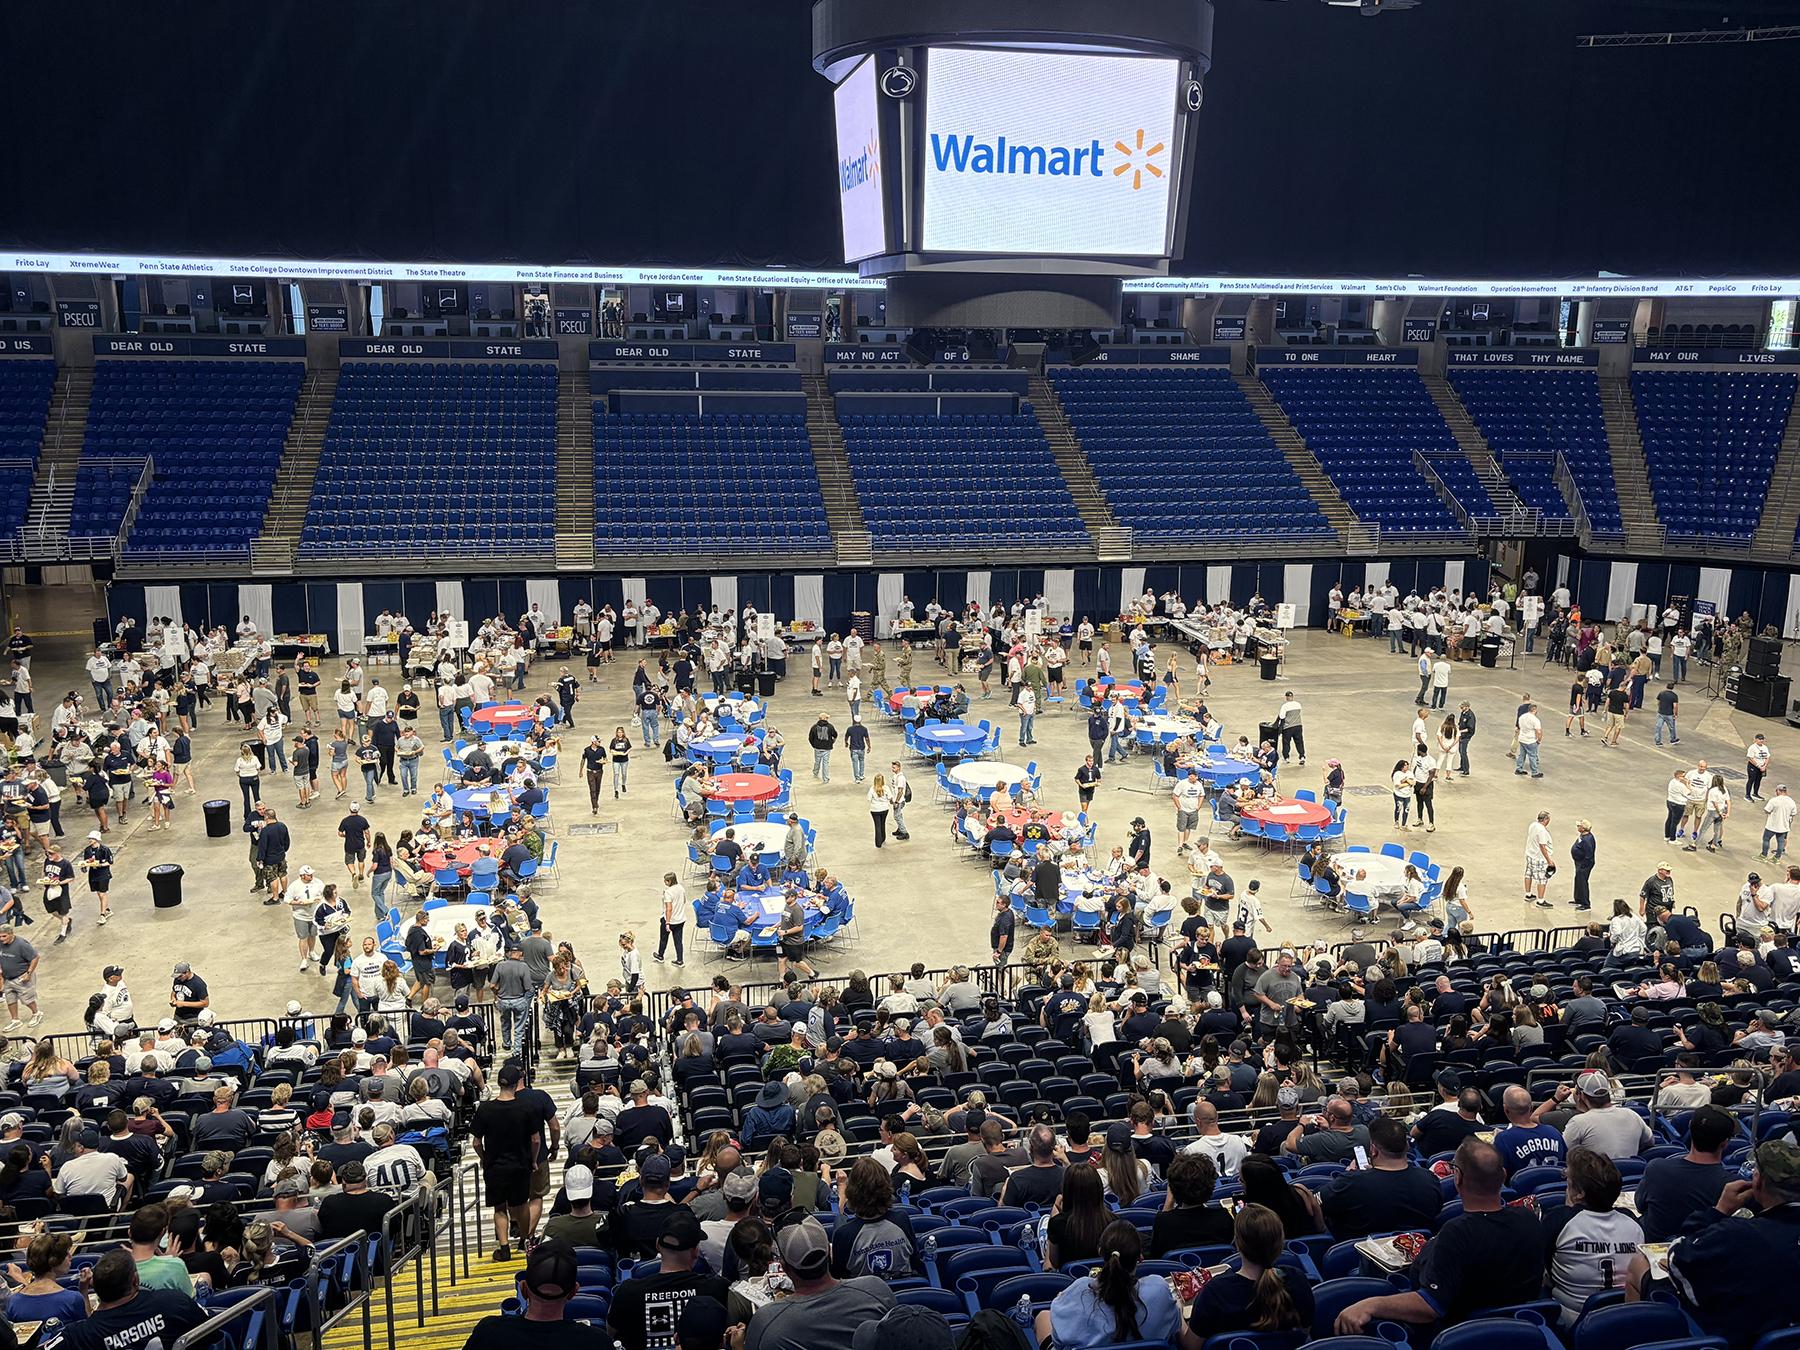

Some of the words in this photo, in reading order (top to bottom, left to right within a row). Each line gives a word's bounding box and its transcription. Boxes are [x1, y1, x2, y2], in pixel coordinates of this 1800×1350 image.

[930, 133, 1104, 177] Walmart
[840, 145, 869, 194] Walmart
[15, 259, 34, 267] Frito
[36, 259, 50, 268] Lay
[70, 260, 120, 269] XtremeWear
[139, 262, 158, 270] Penn
[160, 263, 180, 271] State
[181, 263, 214, 272] Athletics
[230, 265, 249, 273] State
[250, 265, 277, 274] College
[278, 266, 318, 274] Downtown
[318, 267, 367, 276] Improvement
[439, 269, 466, 277] Theatre
[639, 273, 658, 281] Bryce
[658, 273, 680, 281] Jordan
[753, 275, 789, 283] Educational
[790, 276, 811, 285] Equity
[816, 276, 836, 284] Office
[837, 277, 844, 285] of
[1144, 281, 1155, 289] and
[1156, 282, 1189, 290] Community
[1586, 285, 1613, 293] Infantry
[1708, 285, 1737, 293] PepsiCo
[1769, 285, 1782, 293] Lay
[64, 312, 95, 326] PSECU
[560, 321, 586, 334] PSECU
[1407, 329, 1431, 341] PSECU
[14, 340, 34, 350] US.
[110, 341, 143, 351] DEAR
[150, 342, 173, 351] OLD
[229, 343, 267, 353] STATE
[366, 345, 395, 354] DEAR
[402, 345, 423, 354] OLD
[486, 346, 522, 355] STATE
[615, 348, 643, 357] DEAR
[648, 348, 669, 357] OLD
[728, 349, 762, 358] STATE
[836, 351, 856, 360] MAY
[862, 351, 875, 360] NO
[880, 351, 900, 360] ACT
[944, 352, 957, 361] OF
[1170, 353, 1200, 361] SHAME
[1284, 353, 1297, 361] TO
[1301, 353, 1319, 361] ONE
[1366, 353, 1397, 362] HEART
[1454, 353, 1478, 362] THAT
[1483, 354, 1514, 362] LOVES
[1531, 354, 1551, 362] THY
[1650, 352, 1672, 361] MAY
[1677, 352, 1699, 361] OUR
[1739, 354, 1776, 363] LIVES
[1515, 1137, 1559, 1159] deGROM
[1614, 1241, 1637, 1254] LIONS
[645, 1288, 697, 1301] FREEDOM
[104, 1313, 166, 1350] PARSONS
